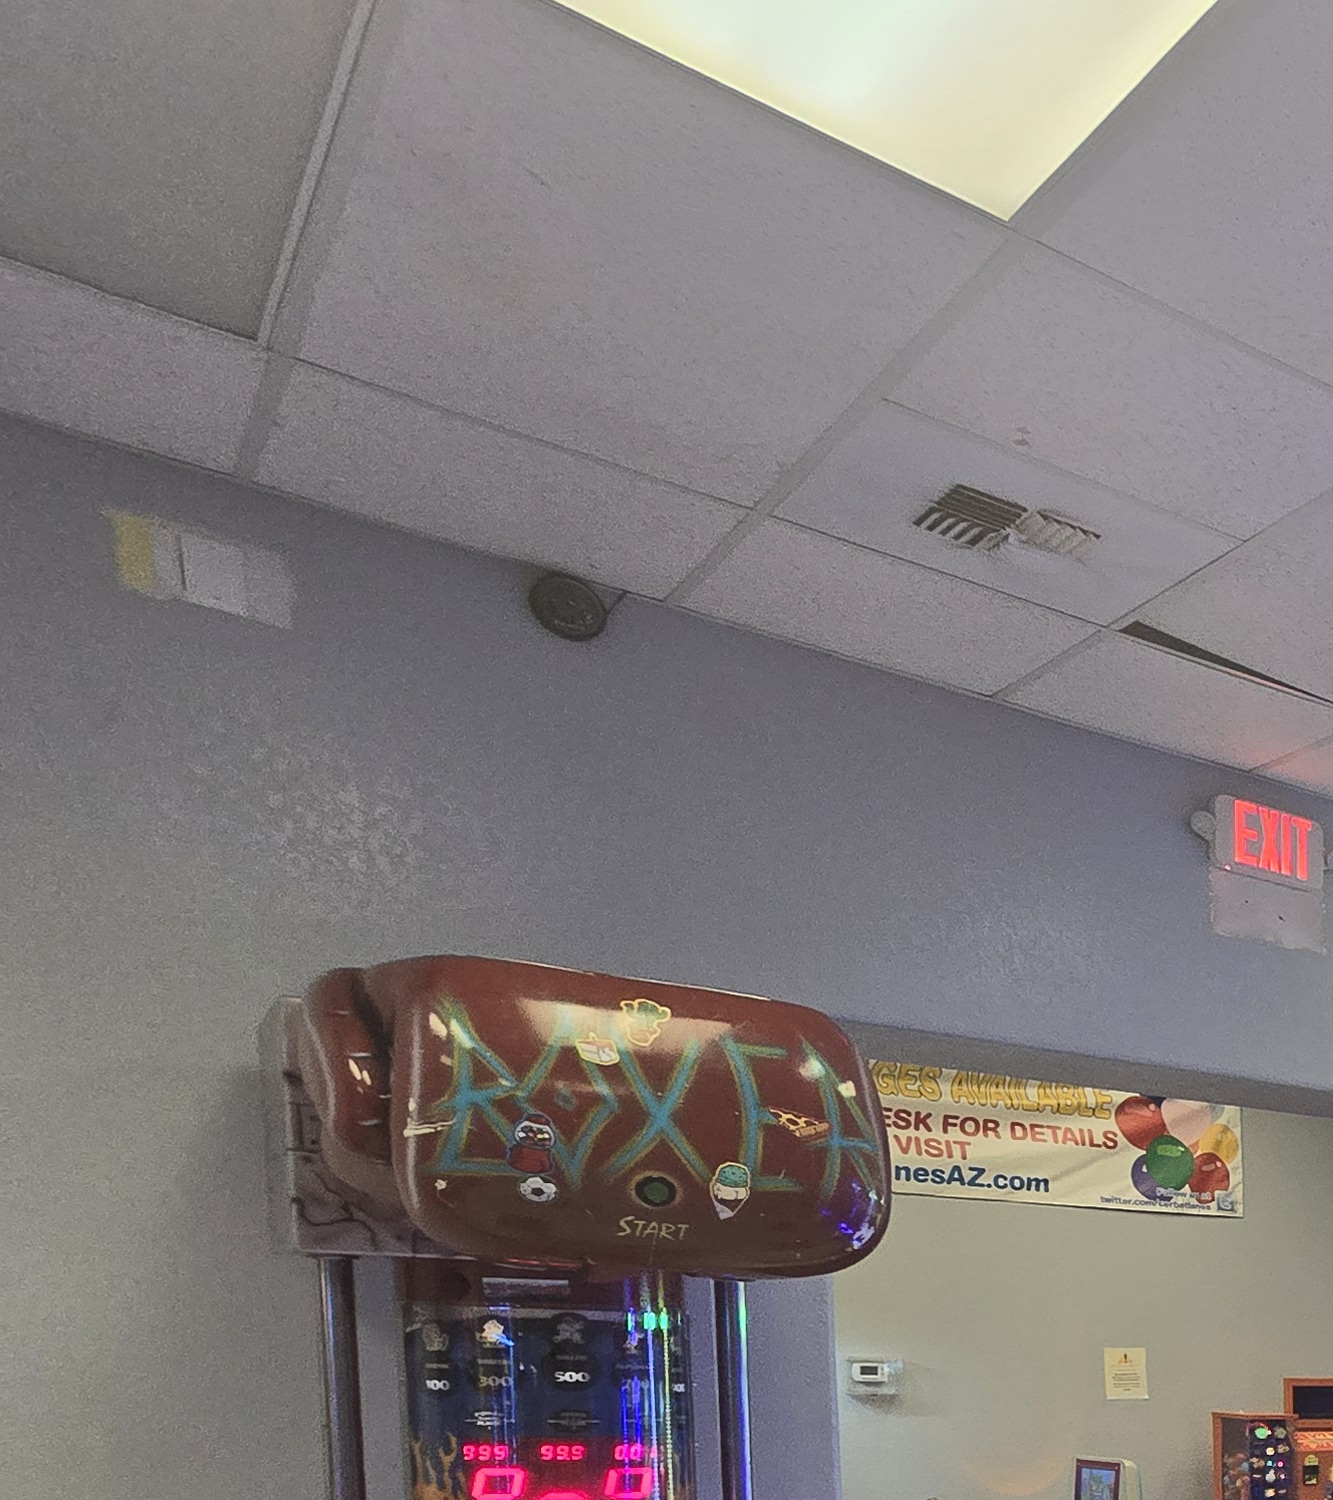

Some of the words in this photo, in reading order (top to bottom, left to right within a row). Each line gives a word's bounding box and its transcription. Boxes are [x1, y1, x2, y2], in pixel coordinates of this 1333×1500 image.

[1233, 799, 1313, 881] EXIT
[428, 994, 881, 1200] BOXER
[950, 1070, 1113, 1120] AVAILABLE
[892, 1134, 972, 1161] VISIT
[942, 1114, 1001, 1139] FOR
[1010, 1121, 1118, 1150] DETAILS
[616, 1215, 690, 1242] START
[553, 1371, 590, 1383] 500
